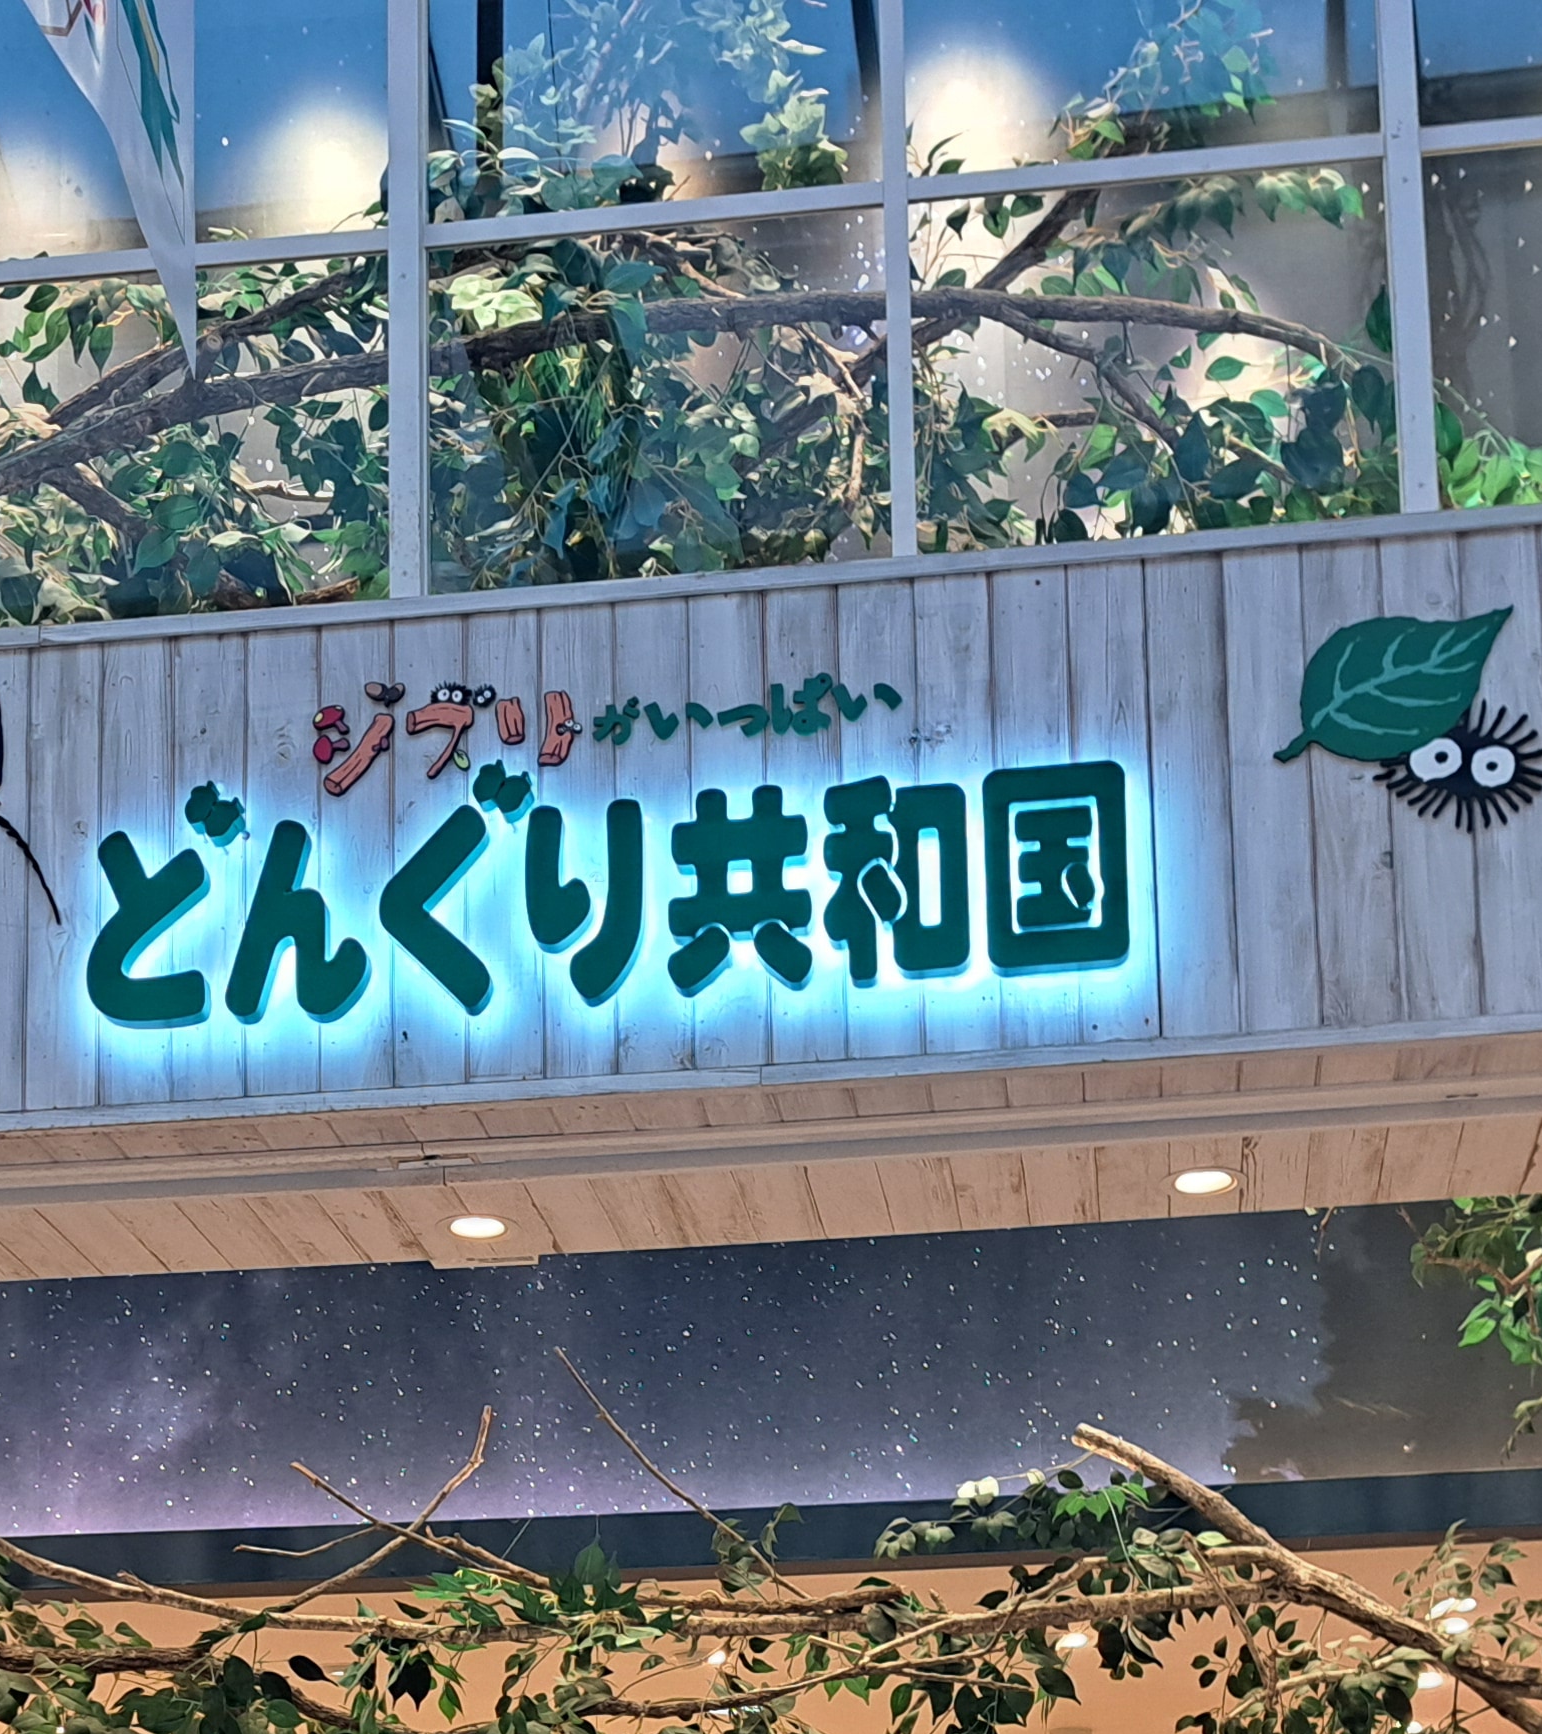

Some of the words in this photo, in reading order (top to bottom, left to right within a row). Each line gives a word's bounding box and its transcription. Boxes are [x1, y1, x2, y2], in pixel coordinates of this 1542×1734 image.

[312, 672, 903, 796] ジブリがいっぱい
[87, 757, 1130, 1027] どんぐり共和国
